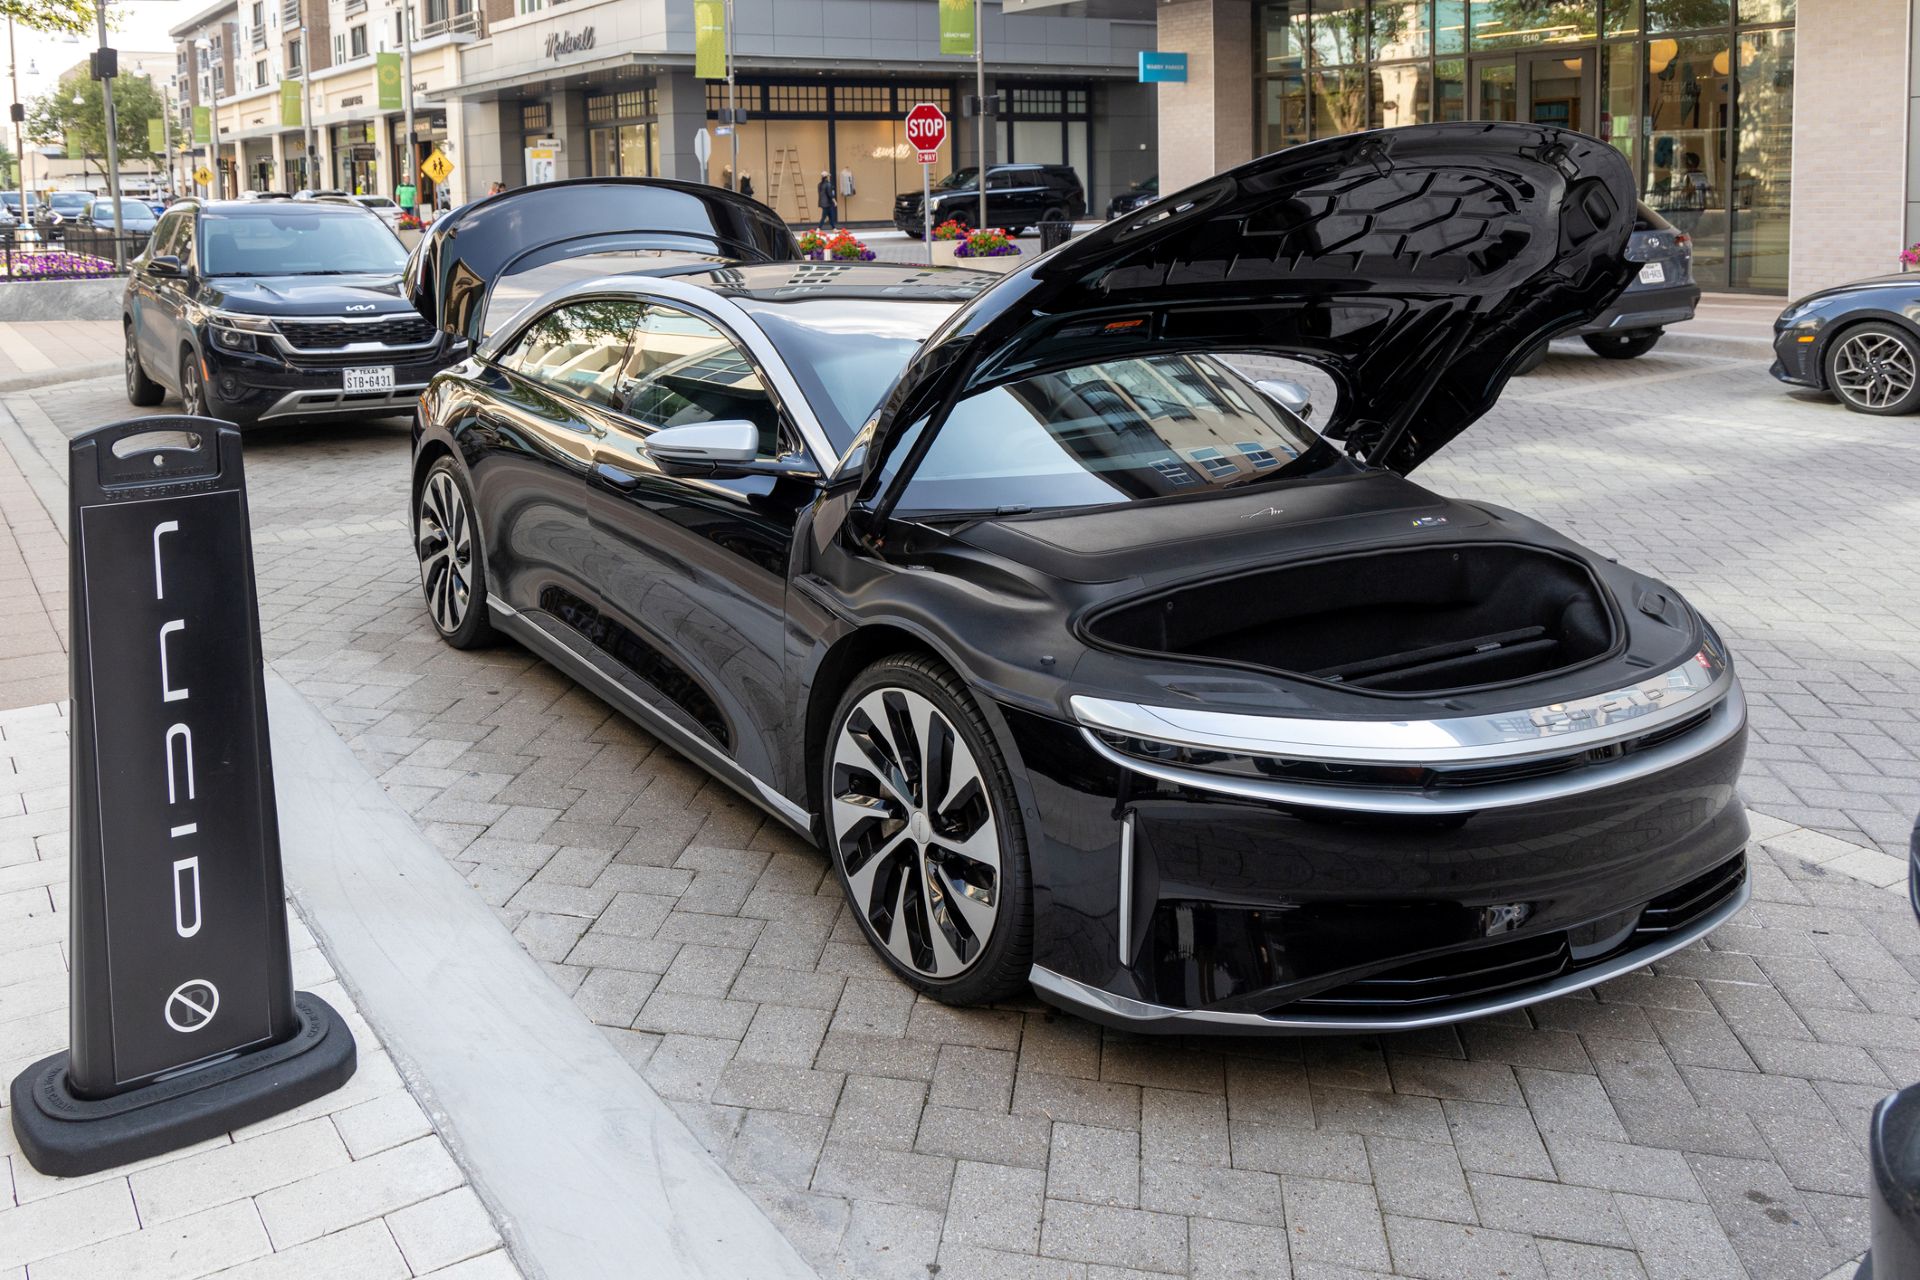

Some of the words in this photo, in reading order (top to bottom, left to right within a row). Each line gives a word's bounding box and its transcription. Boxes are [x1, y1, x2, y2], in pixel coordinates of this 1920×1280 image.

[909, 118, 943, 137] STOP
[918, 153, 936, 162] 3-WAY
[180, 480, 219, 492] PANEL
[1529, 688, 1664, 727] LUCID
[153, 520, 202, 938] LUCID
